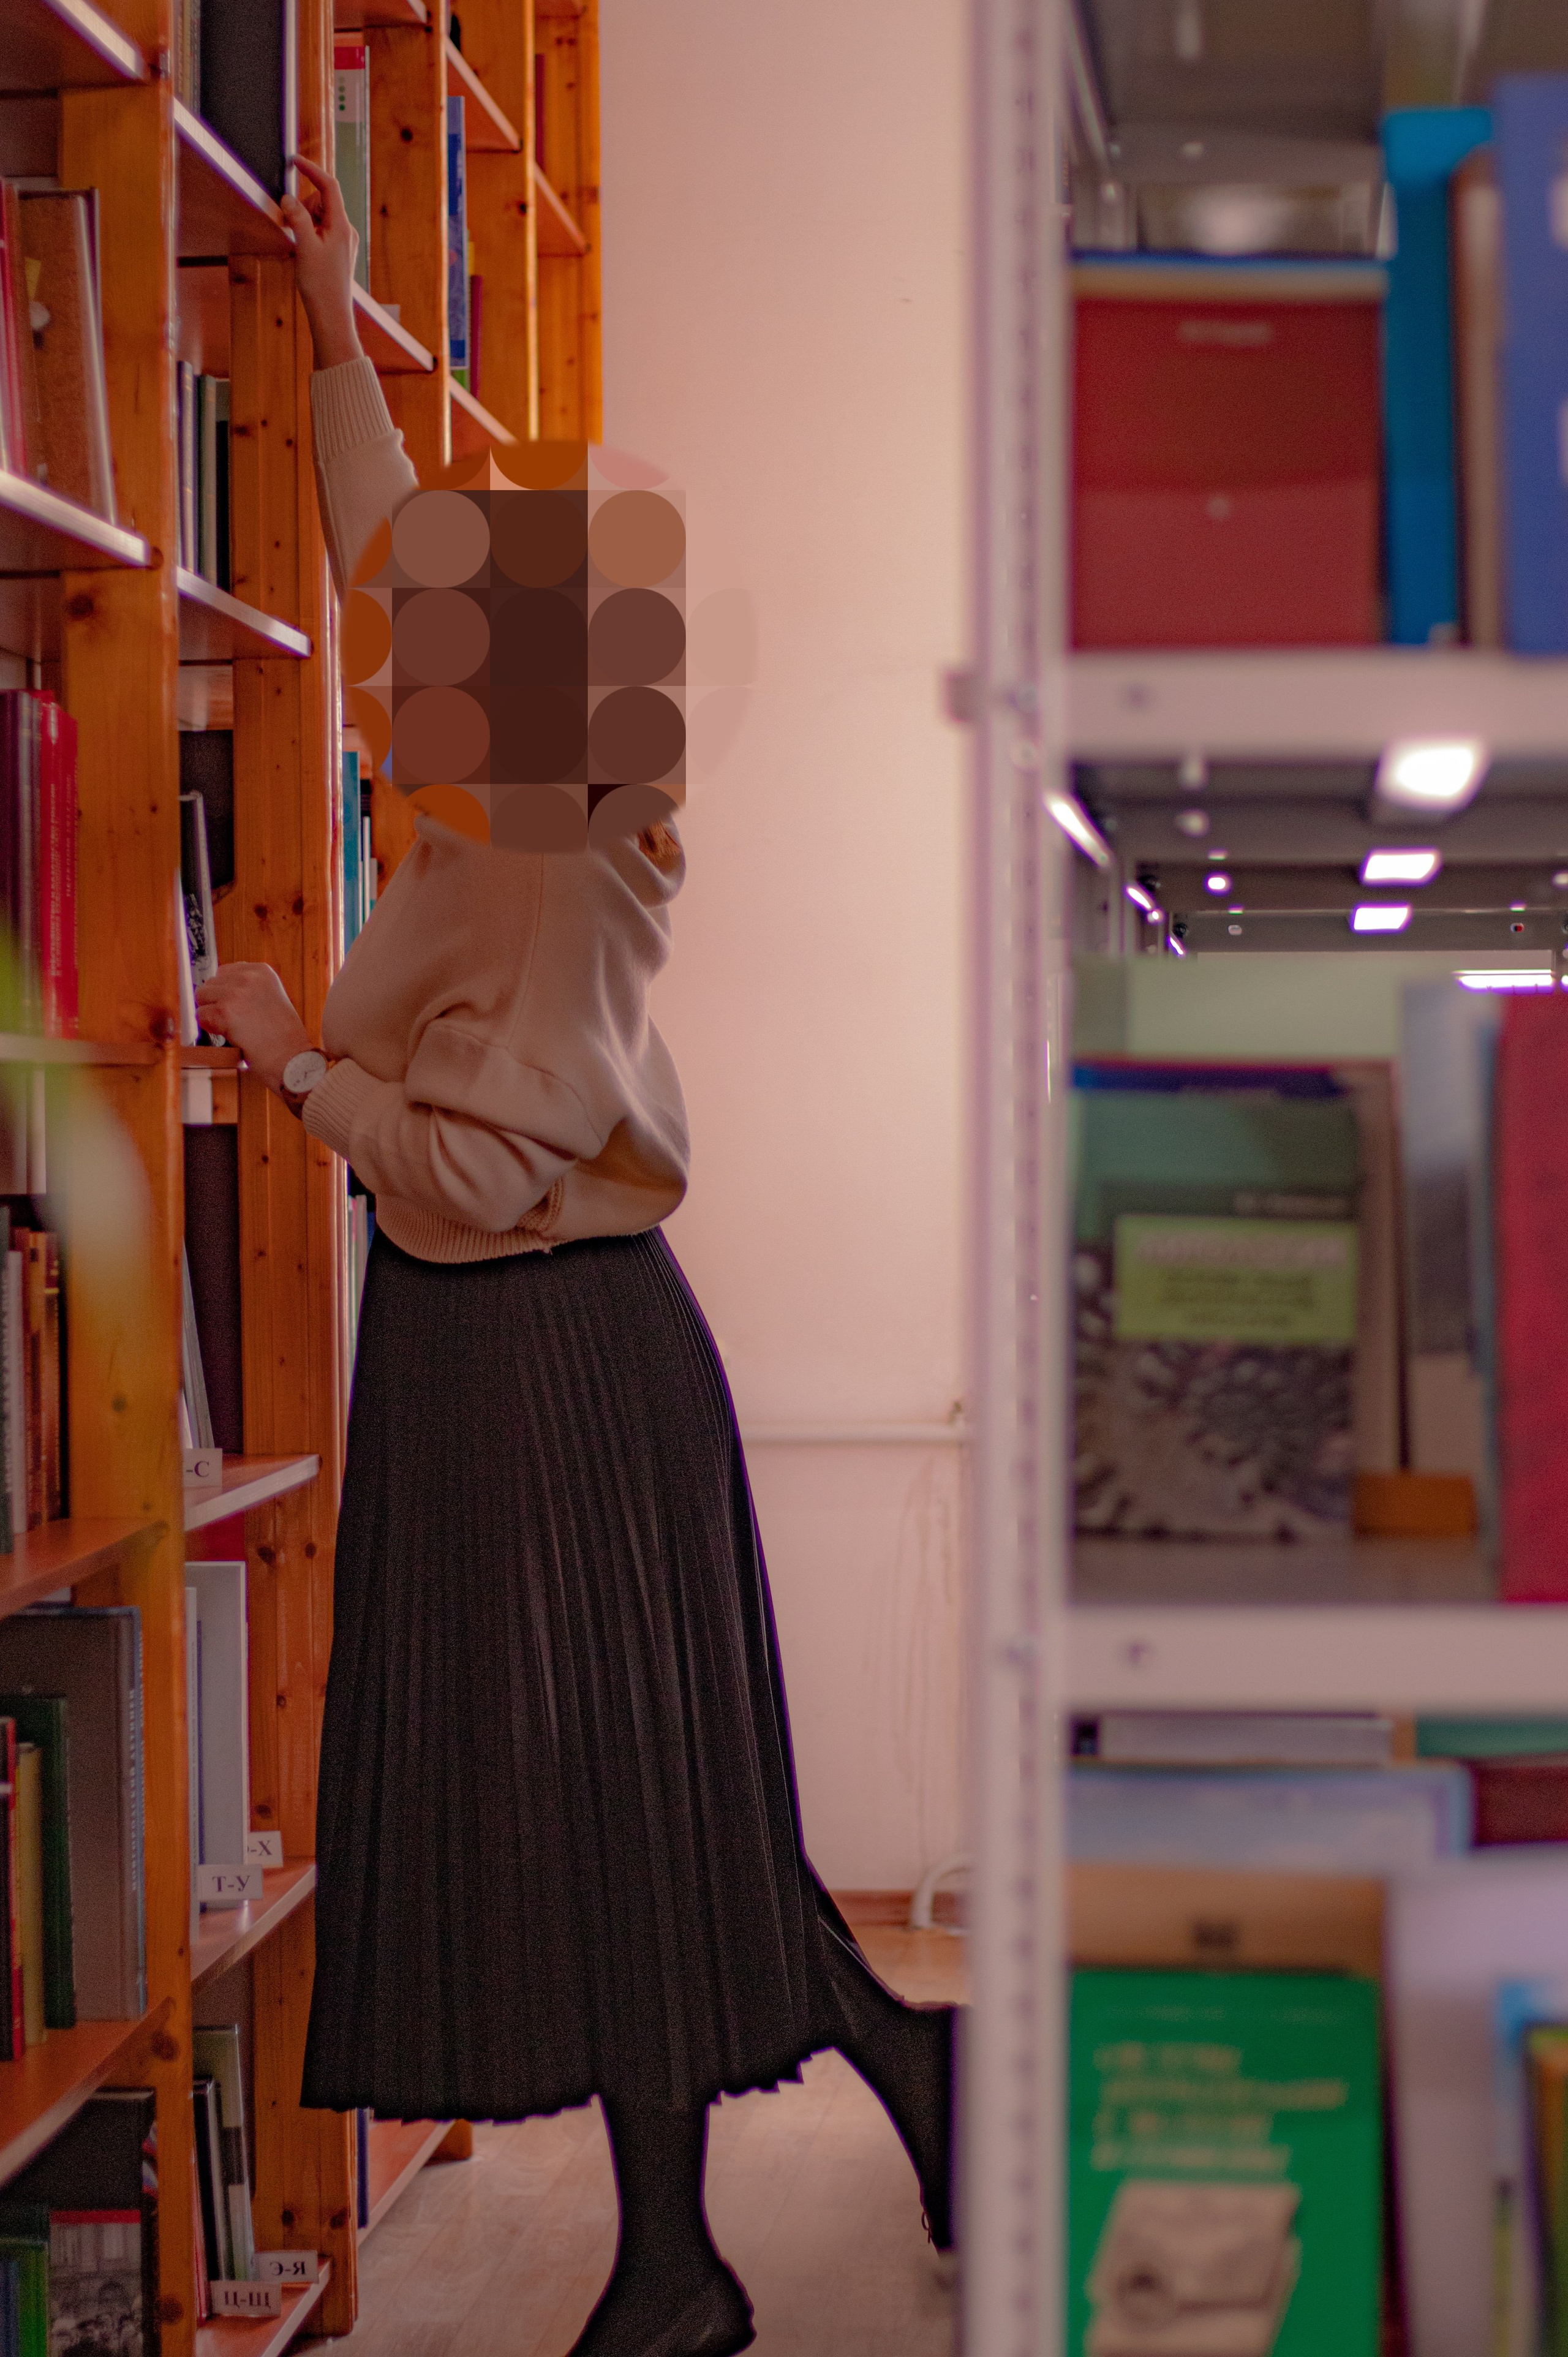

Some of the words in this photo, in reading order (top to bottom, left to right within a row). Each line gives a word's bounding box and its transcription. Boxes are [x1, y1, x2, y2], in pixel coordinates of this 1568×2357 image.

[186, 1460, 209, 1477] -С
[247, 1840, 272, 1856] -Х
[212, 1875, 251, 1892] Т-У
[270, 2261, 306, 2276] Э-Я
